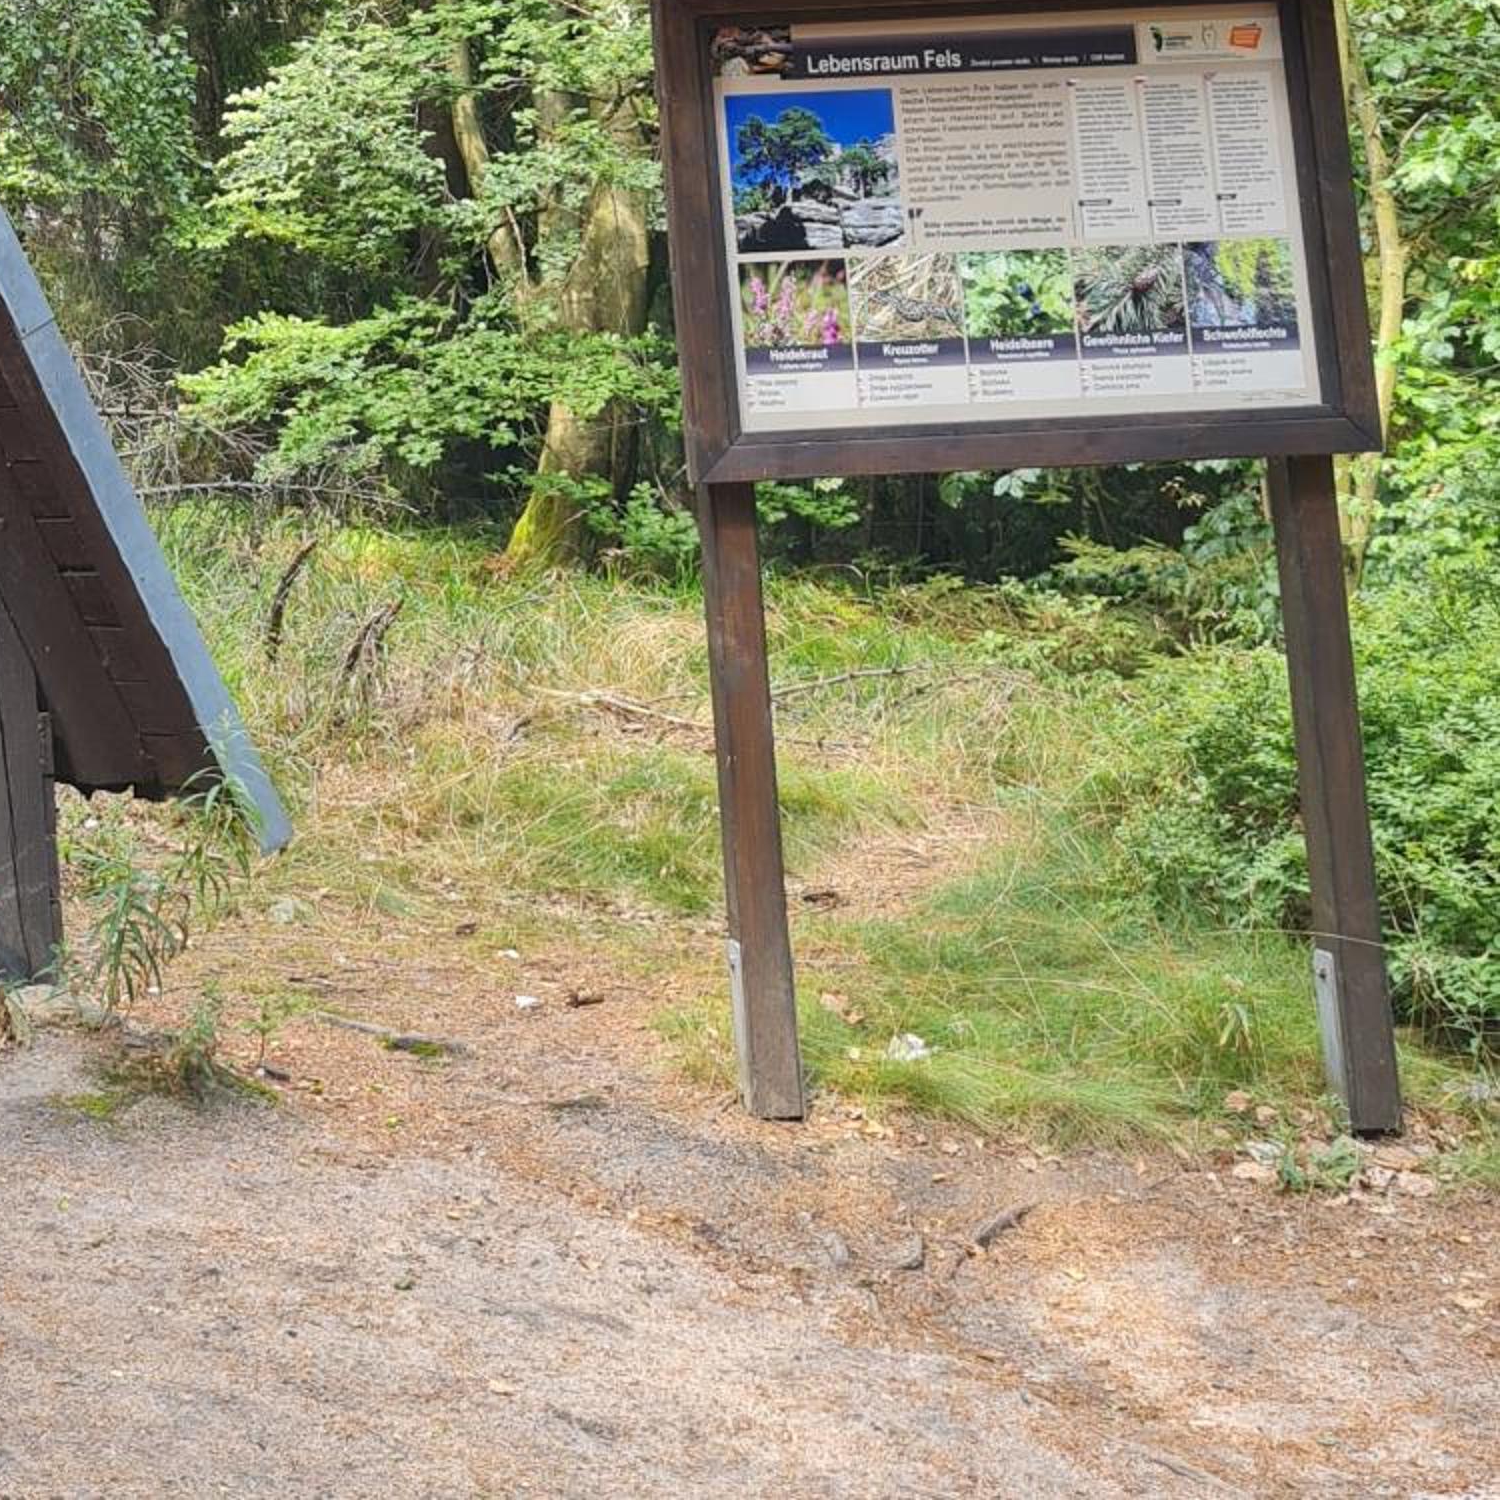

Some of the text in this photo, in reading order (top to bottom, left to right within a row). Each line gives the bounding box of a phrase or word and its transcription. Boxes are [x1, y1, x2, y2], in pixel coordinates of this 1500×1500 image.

[807, 54, 919, 74] Lebensraum
[923, 49, 962, 68] Fels
[991, 338, 1055, 353] Heidelbeere
[1083, 334, 1150, 348] Gewöhnliche
[1152, 332, 1185, 345] Kiefer
[769, 348, 828, 361] Heidekraut
[882, 343, 939, 356] Kreuzotter
